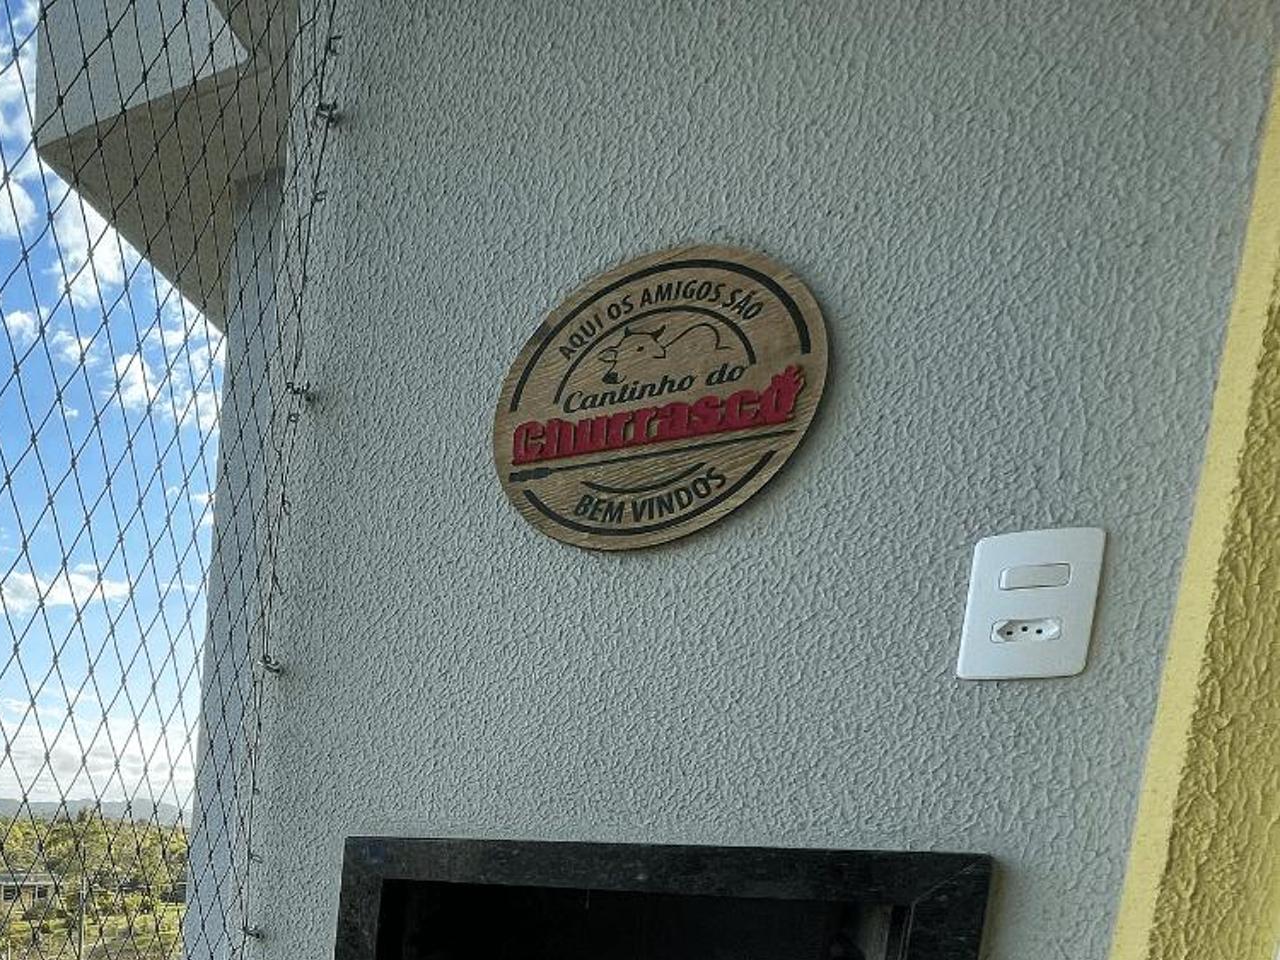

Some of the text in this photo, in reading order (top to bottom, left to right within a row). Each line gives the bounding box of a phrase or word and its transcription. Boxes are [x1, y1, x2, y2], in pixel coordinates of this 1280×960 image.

[559, 314, 604, 361] AQUI
[607, 295, 634, 321] OS
[640, 280, 726, 308] AMIGOS
[563, 363, 748, 413] Cantinho do
[574, 466, 727, 524] BEM VINDOS
